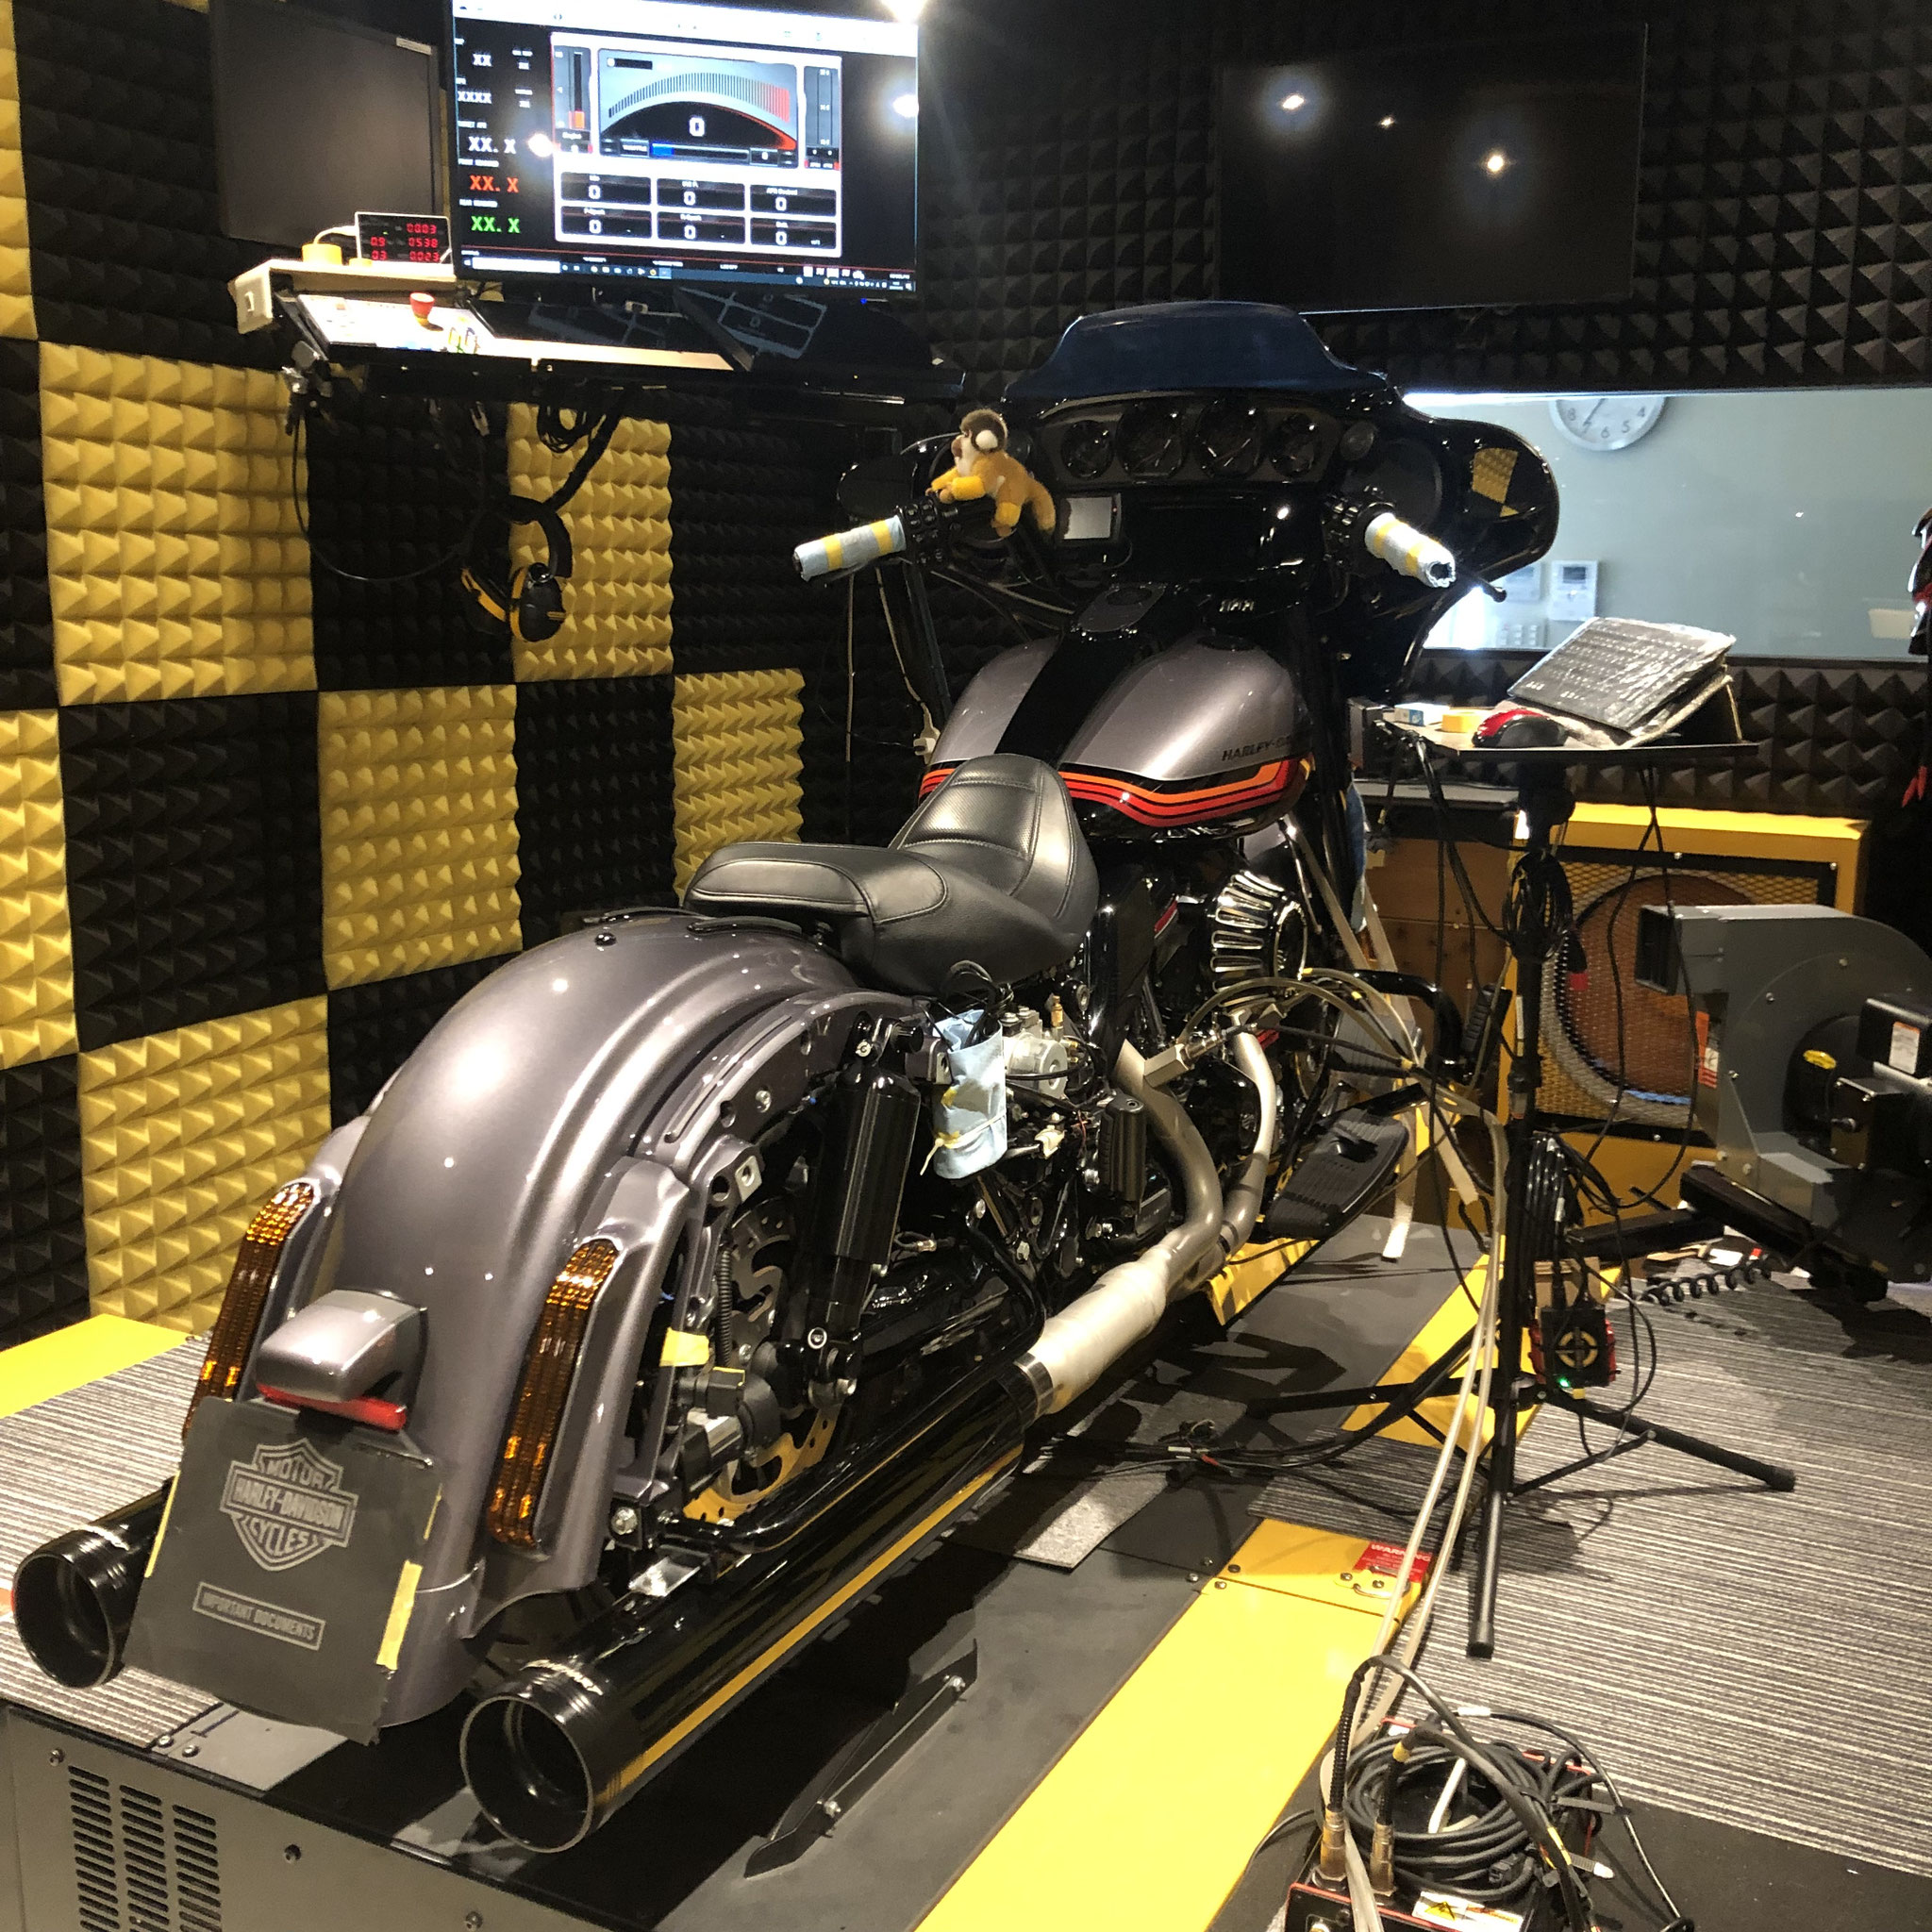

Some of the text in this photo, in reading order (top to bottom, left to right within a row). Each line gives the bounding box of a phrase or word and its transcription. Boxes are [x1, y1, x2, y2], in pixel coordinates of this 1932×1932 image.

[1600, 425, 1610, 440] 6
[1621, 417, 1631, 434] 5
[266, 1457, 325, 1489] MOTOR
[249, 1516, 310, 1557] CYCLES
